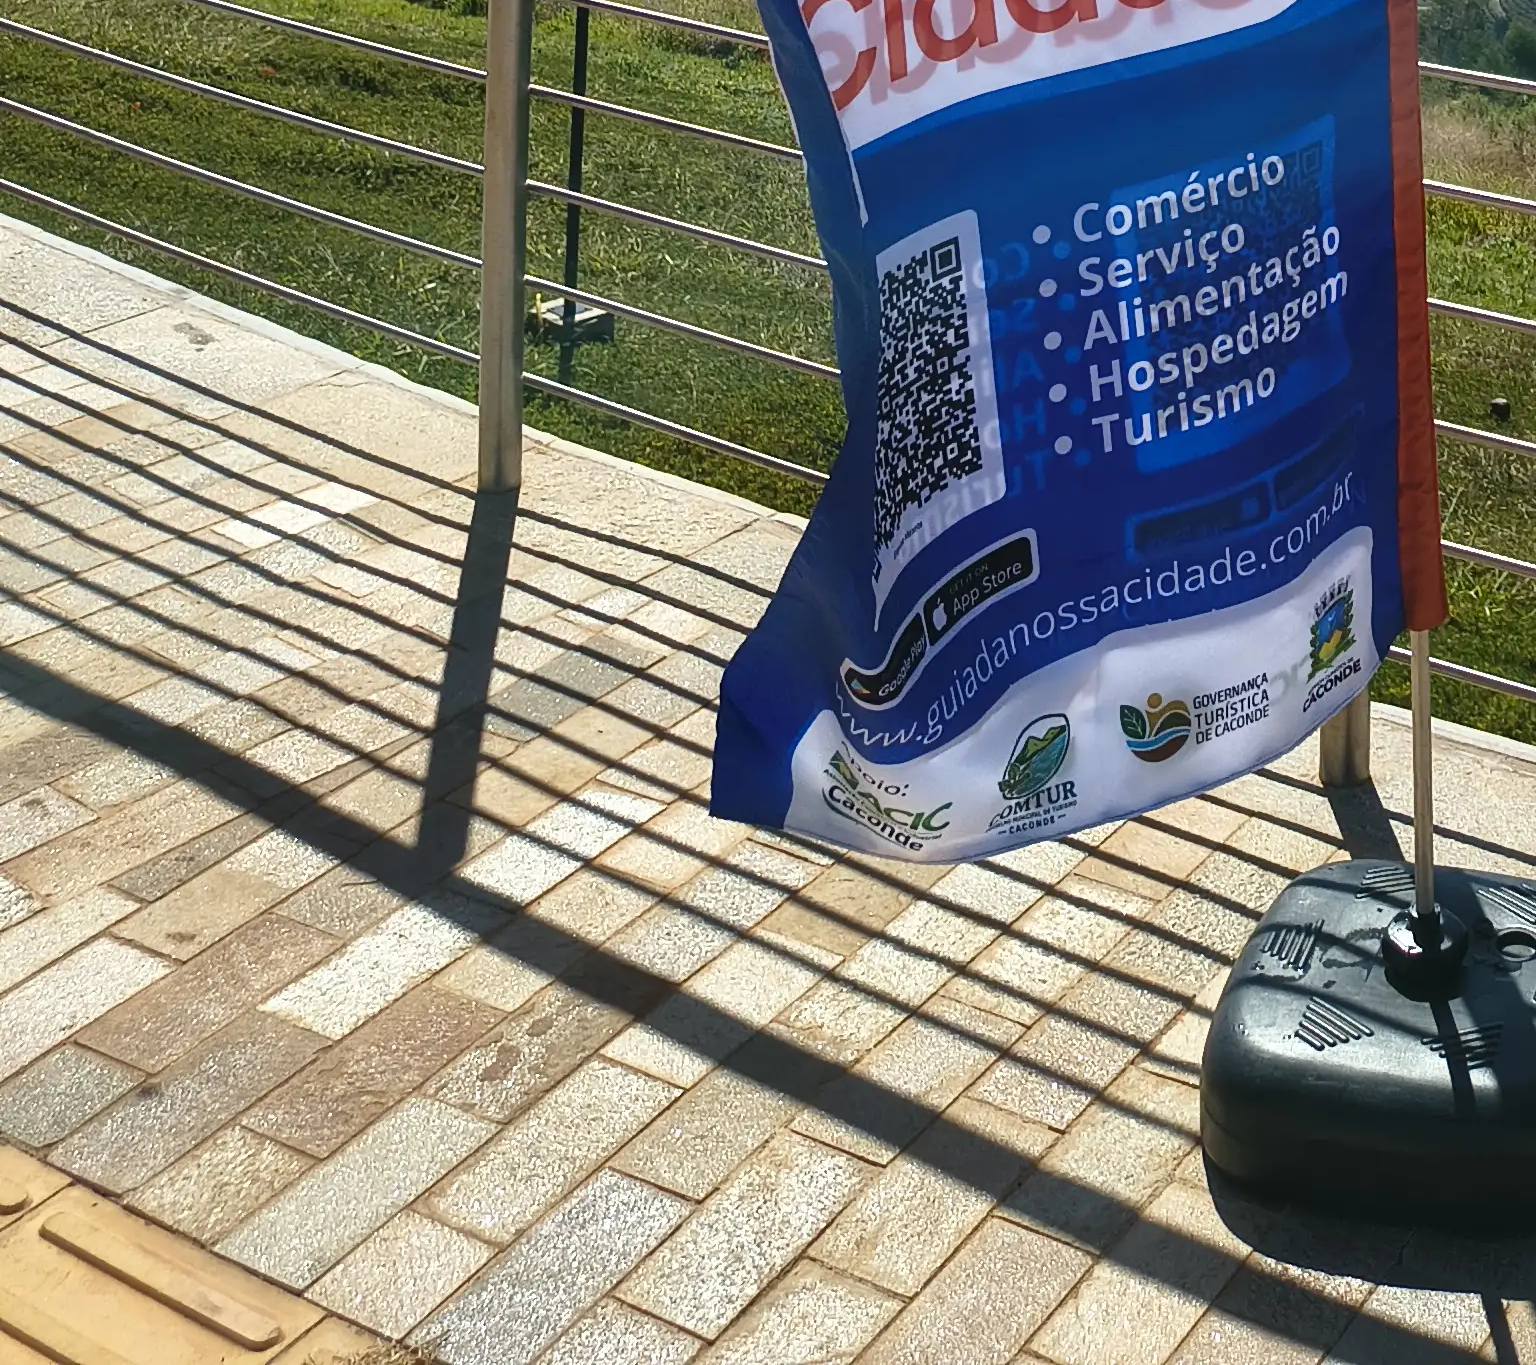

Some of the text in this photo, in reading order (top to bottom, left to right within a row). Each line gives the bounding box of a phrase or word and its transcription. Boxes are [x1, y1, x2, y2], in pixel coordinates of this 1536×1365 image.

[1073, 152, 1286, 243] Comércio
[1079, 221, 1245, 297] Serviço
[1083, 225, 1341, 351] Alimentação
[1089, 271, 1348, 401] Hospedagem
[1091, 367, 1276, 455] Turismo
[952, 561, 1022, 615] App Store
[878, 635, 926, 697] Google Play
[1192, 672, 1269, 709] GOVERNANÇA
[1303, 658, 1362, 712] CACONDE
[1194, 689, 1269, 729] TURÍSTICA
[1196, 704, 1270, 745] DE CACONDE
[828, 785, 924, 851] Caconde
